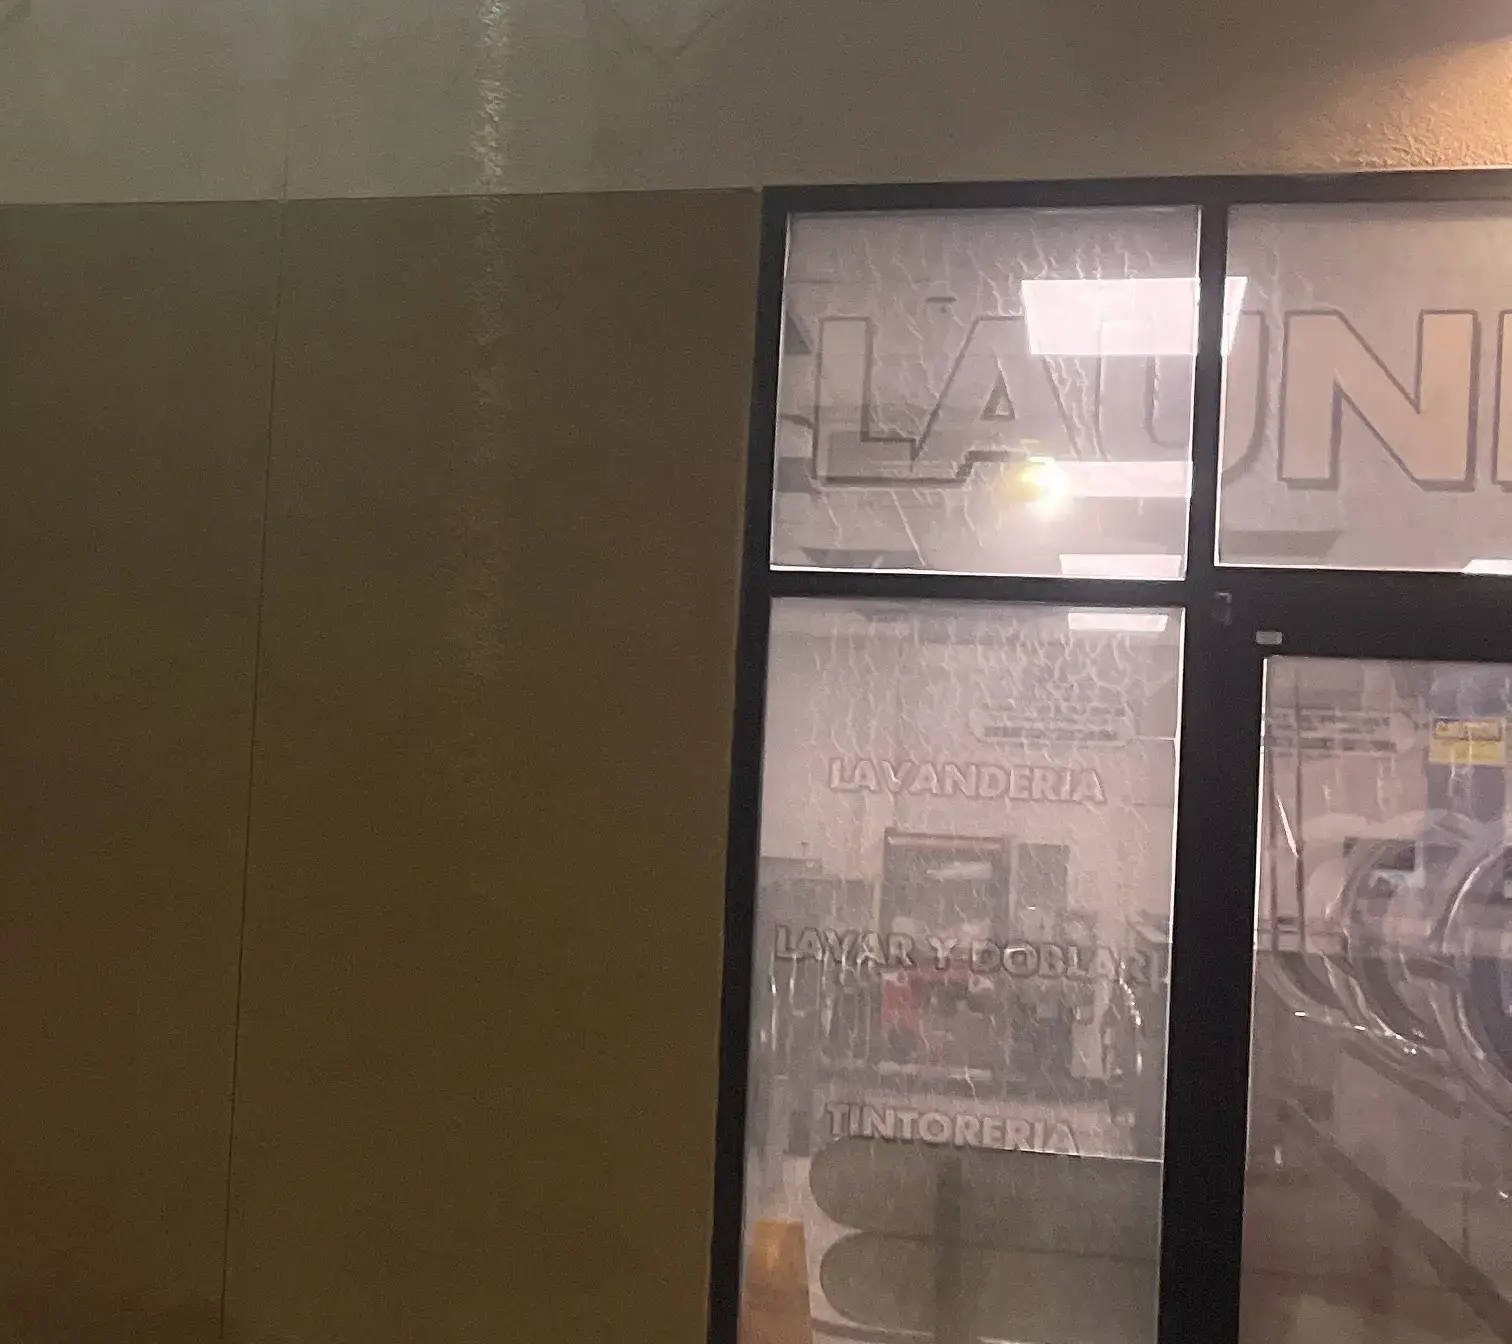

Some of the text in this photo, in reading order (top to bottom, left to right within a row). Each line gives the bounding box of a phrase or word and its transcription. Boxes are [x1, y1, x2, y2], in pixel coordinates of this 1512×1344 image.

[813, 306, 1512, 491] LAUN
[827, 756, 1108, 806] LAVANDERIA
[773, 923, 918, 972] LAVAR
[927, 933, 961, 972] Y
[826, 1101, 1083, 1156] TINTORERIA
